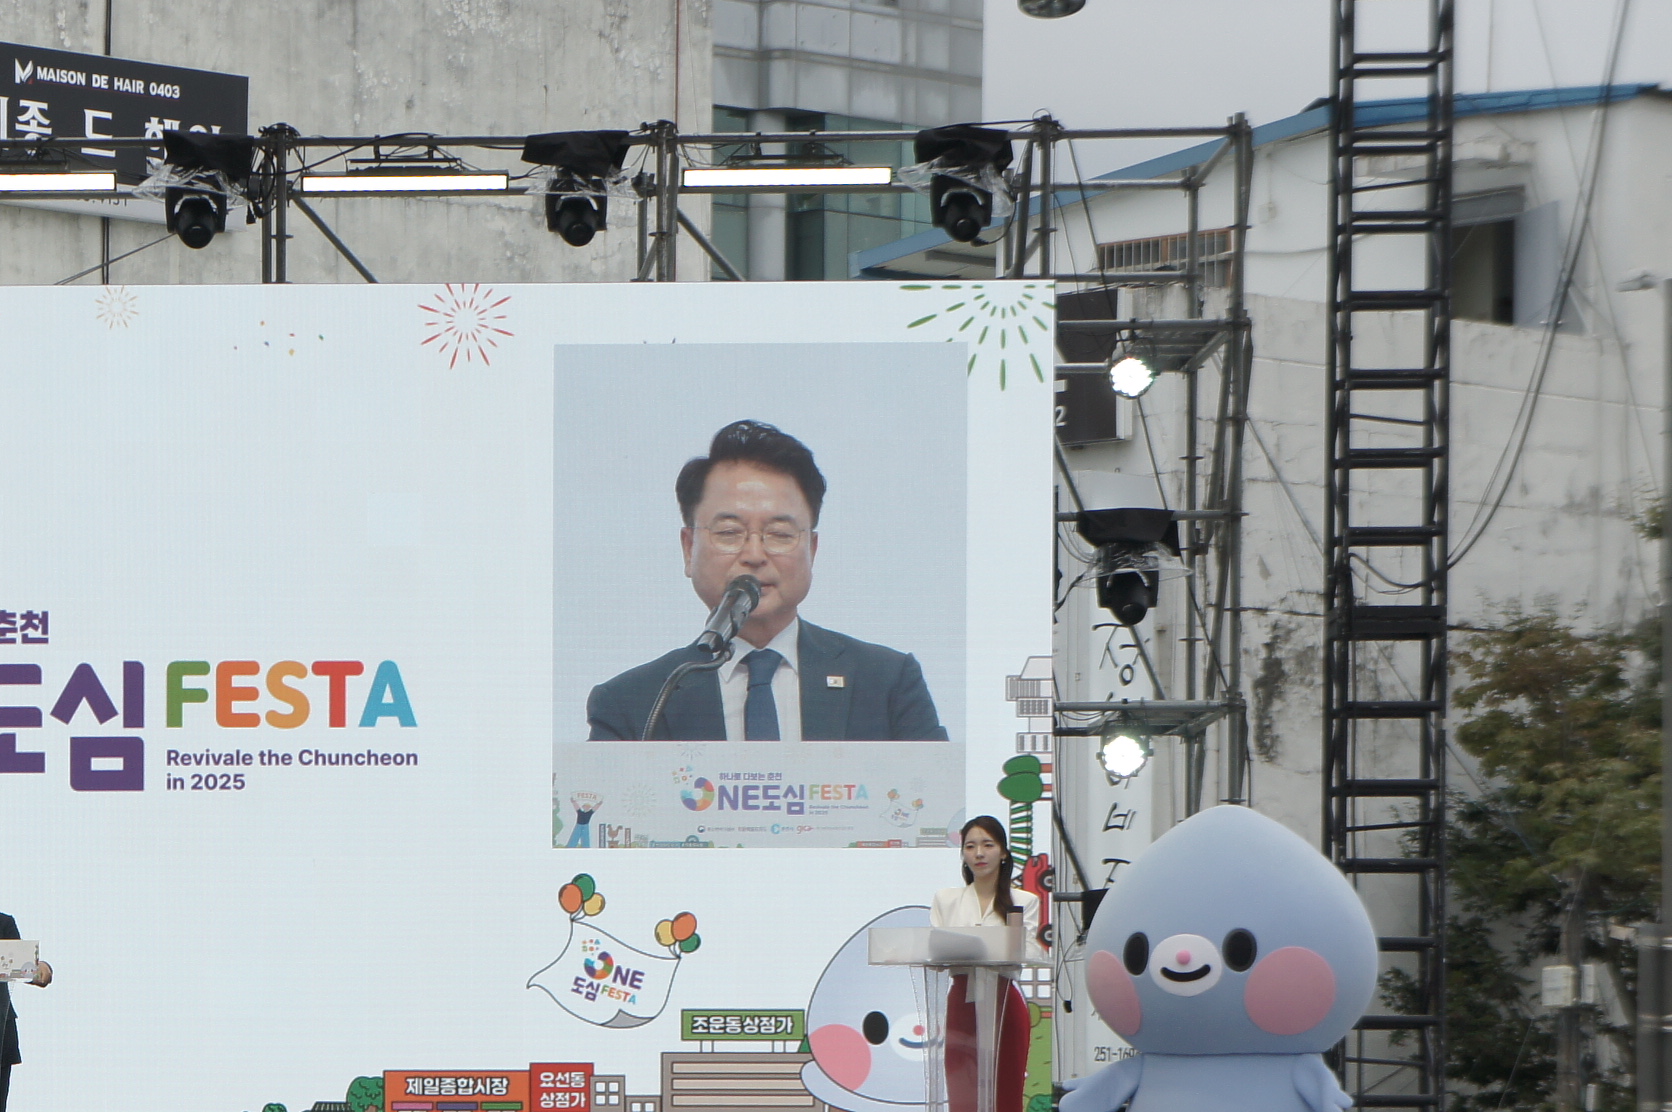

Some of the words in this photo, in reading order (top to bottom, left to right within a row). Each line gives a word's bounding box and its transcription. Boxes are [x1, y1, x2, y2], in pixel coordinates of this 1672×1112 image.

[36, 66, 86, 87] MAISON
[92, 73, 109, 89] DE
[113, 76, 144, 94] HAIR
[149, 81, 180, 99] 0403
[166, 660, 418, 729] FESTA
[166, 749, 254, 767] Revivale
[258, 749, 293, 767] the
[298, 749, 419, 767] Chuncheon
[166, 773, 184, 791] in
[190, 774, 246, 791] 2025
[809, 784, 870, 801] FESTA
[584, 951, 645, 990] ONE
[571, 976, 600, 1002] 도심
[601, 985, 637, 1005] FESTA
[692, 1014, 794, 1036] 조운동상점가
[405, 1075, 510, 1097] 제일종합시장
[539, 1070, 587, 1090] 요선동
[539, 1090, 587, 1110] 상점가
